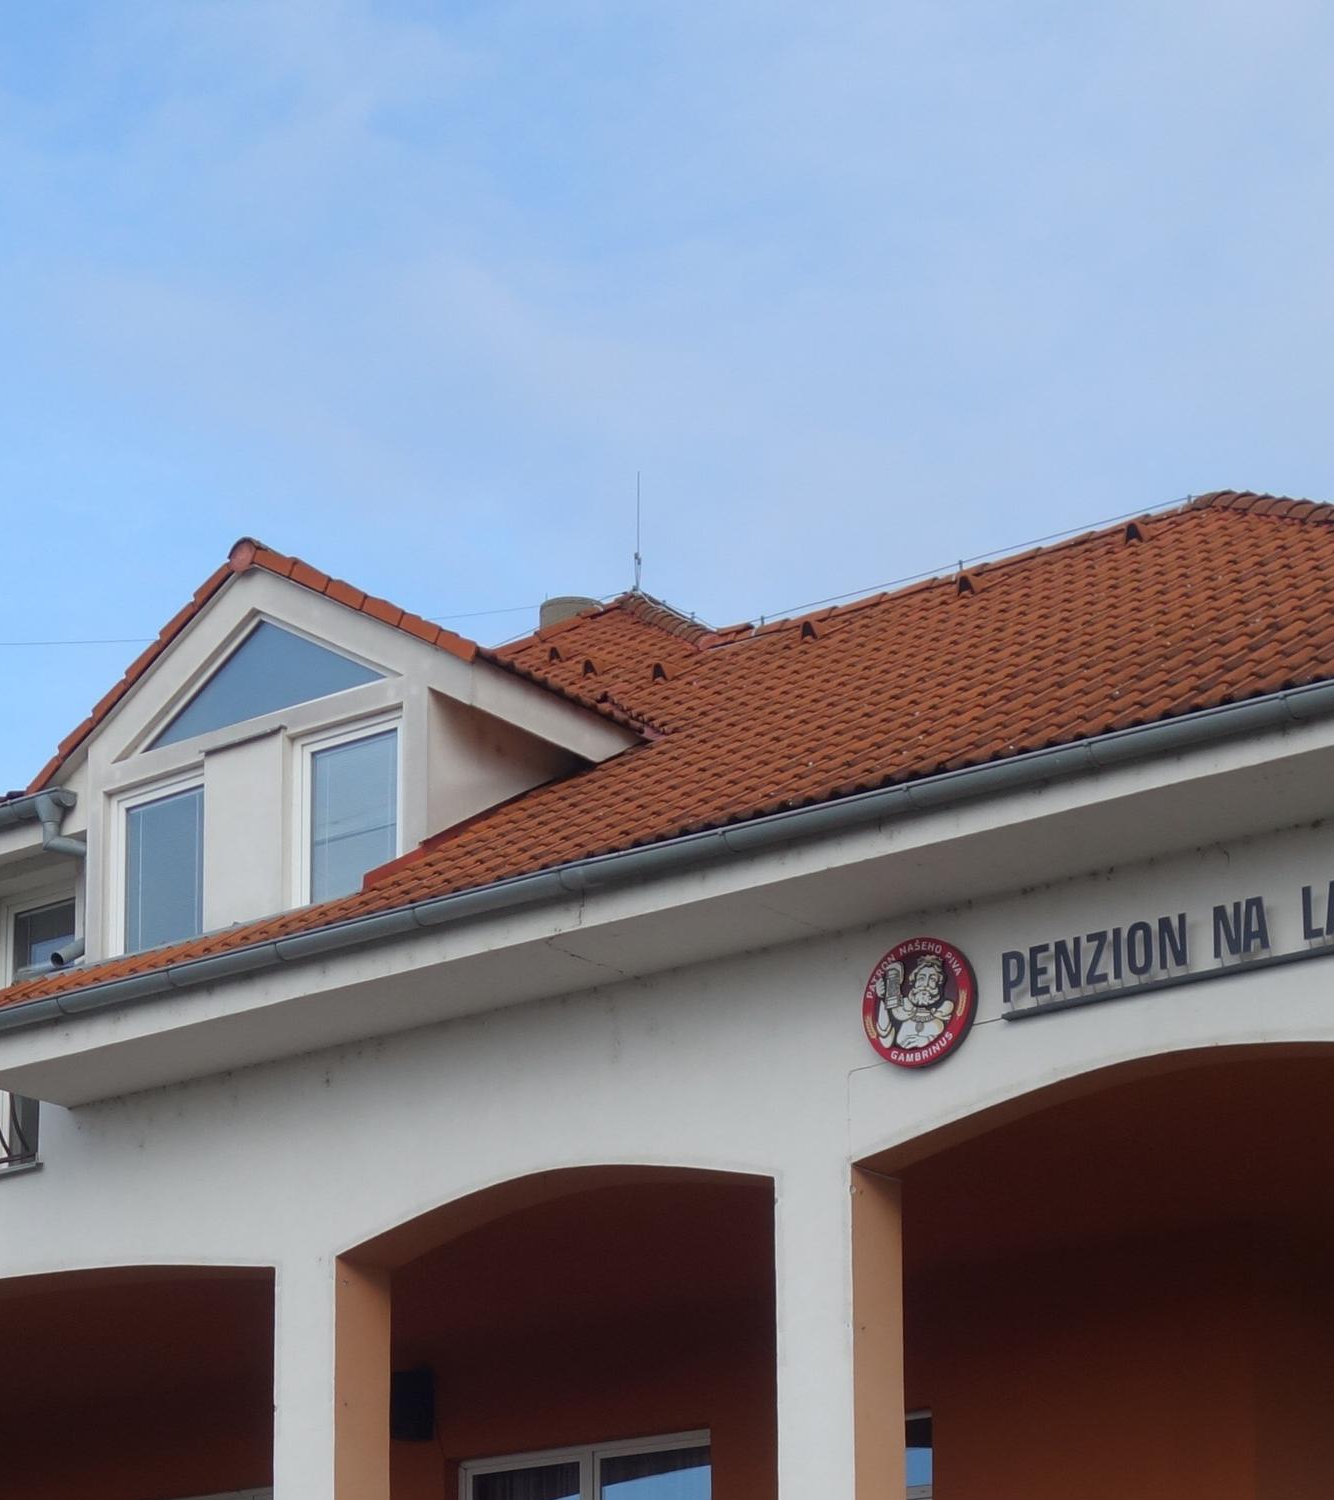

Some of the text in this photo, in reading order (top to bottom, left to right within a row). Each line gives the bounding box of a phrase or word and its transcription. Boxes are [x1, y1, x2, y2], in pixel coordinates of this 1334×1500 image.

[866, 940, 963, 999] PATRON NAŠEHO PIVA
[1002, 913, 1187, 1003] PENZION
[1212, 896, 1270, 959] NA
[890, 1031, 954, 1063] GAMBRINUS
